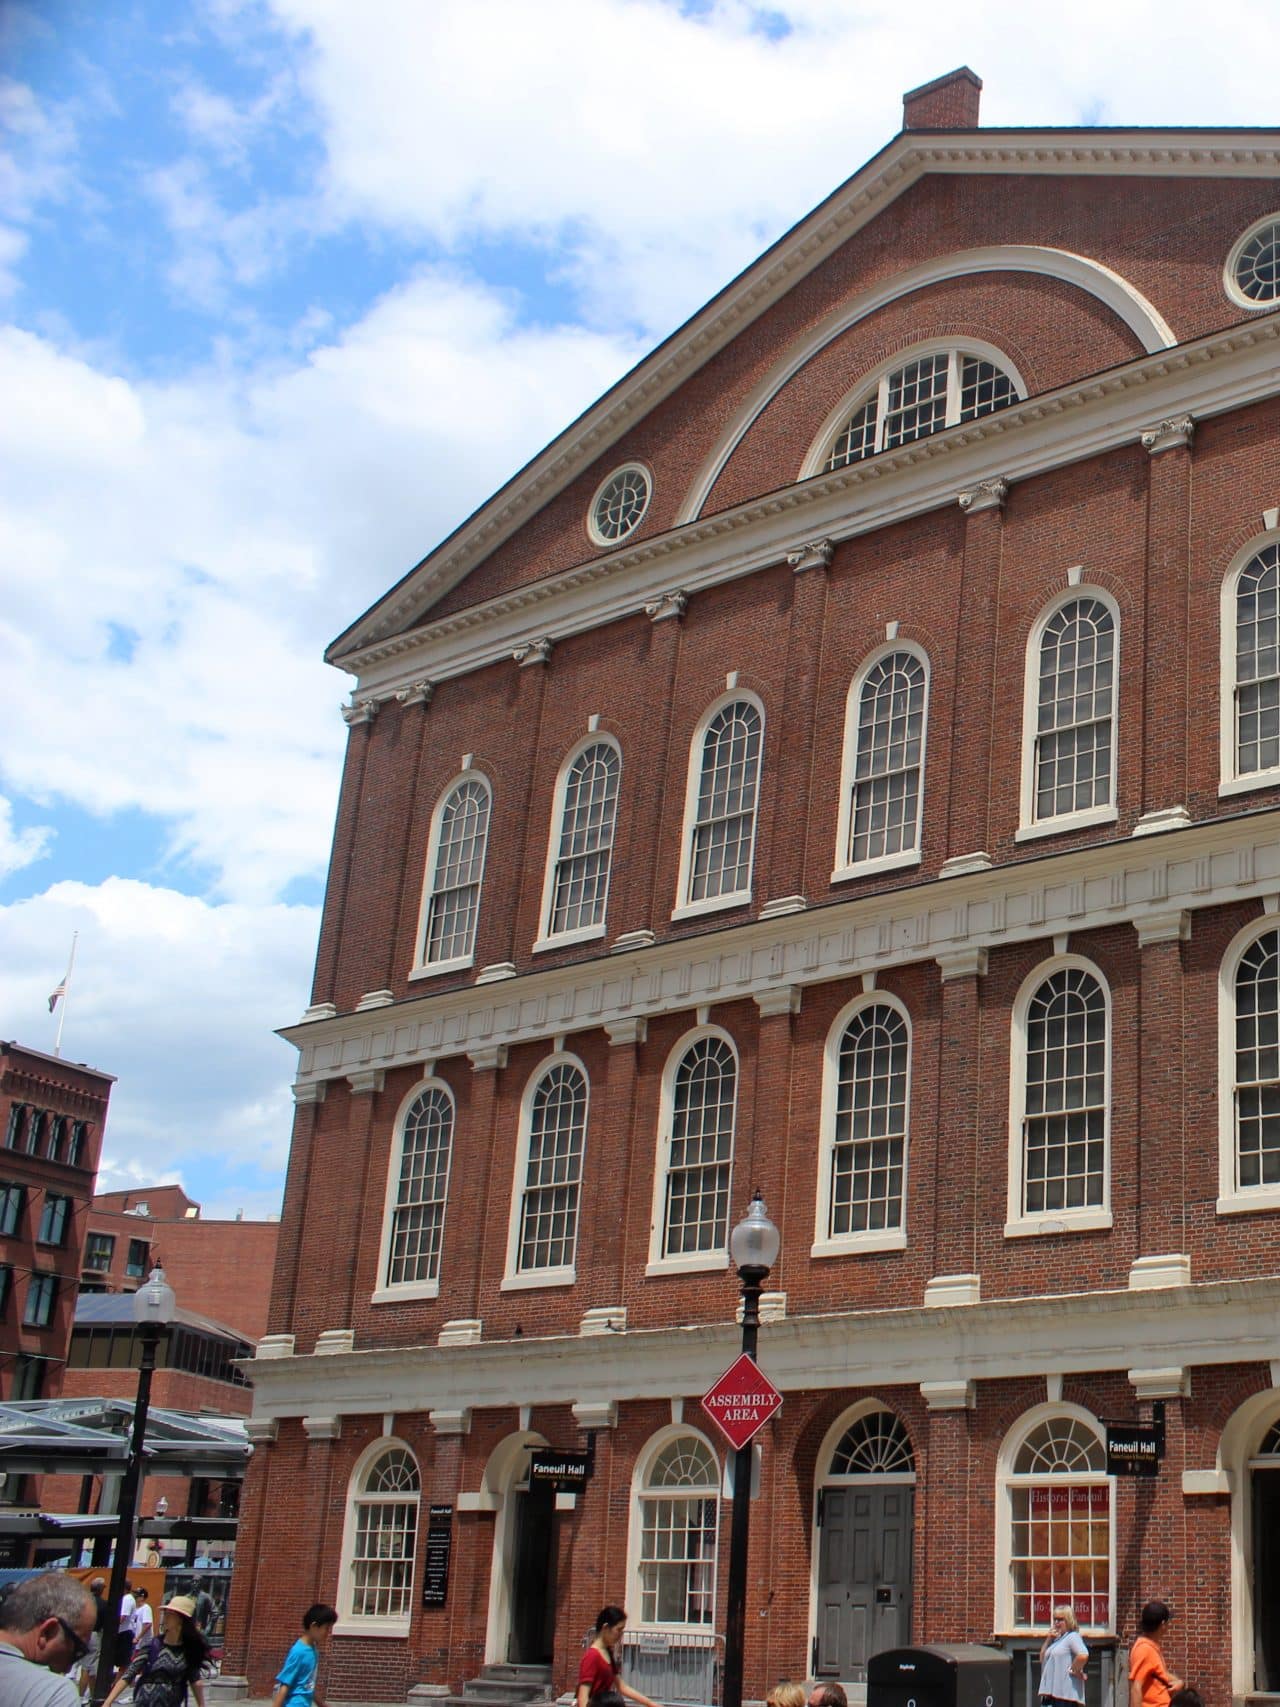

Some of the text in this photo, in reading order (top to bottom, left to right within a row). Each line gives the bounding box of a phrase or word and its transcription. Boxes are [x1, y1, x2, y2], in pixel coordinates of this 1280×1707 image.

[708, 1393, 777, 1407] ASSEMBLY
[722, 1408, 759, 1421] AREA
[1109, 1440, 1156, 1453] Faneuil Hall
[533, 1463, 585, 1475] Faneuil Hall
